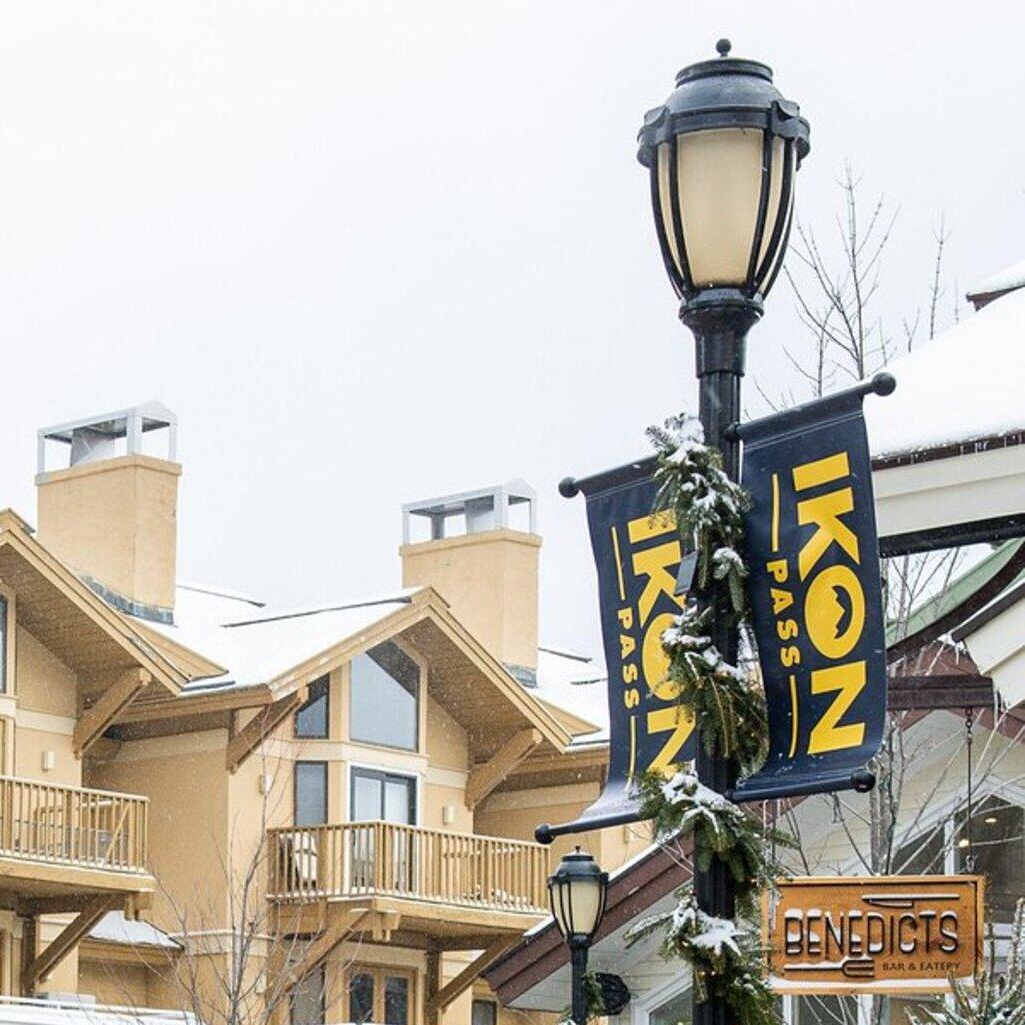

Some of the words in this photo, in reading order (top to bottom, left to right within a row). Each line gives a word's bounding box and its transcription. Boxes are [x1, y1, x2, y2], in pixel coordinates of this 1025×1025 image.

[628, 508, 697, 782] IKON
[766, 558, 801, 668] PASS
[792, 451, 867, 756] IKON
[617, 606, 640, 709] PASS
[784, 908, 960, 957] BENEDICTS
[882, 962, 905, 971] BAR
[908, 962, 916, 971] &
[920, 961, 960, 971] EATERY
